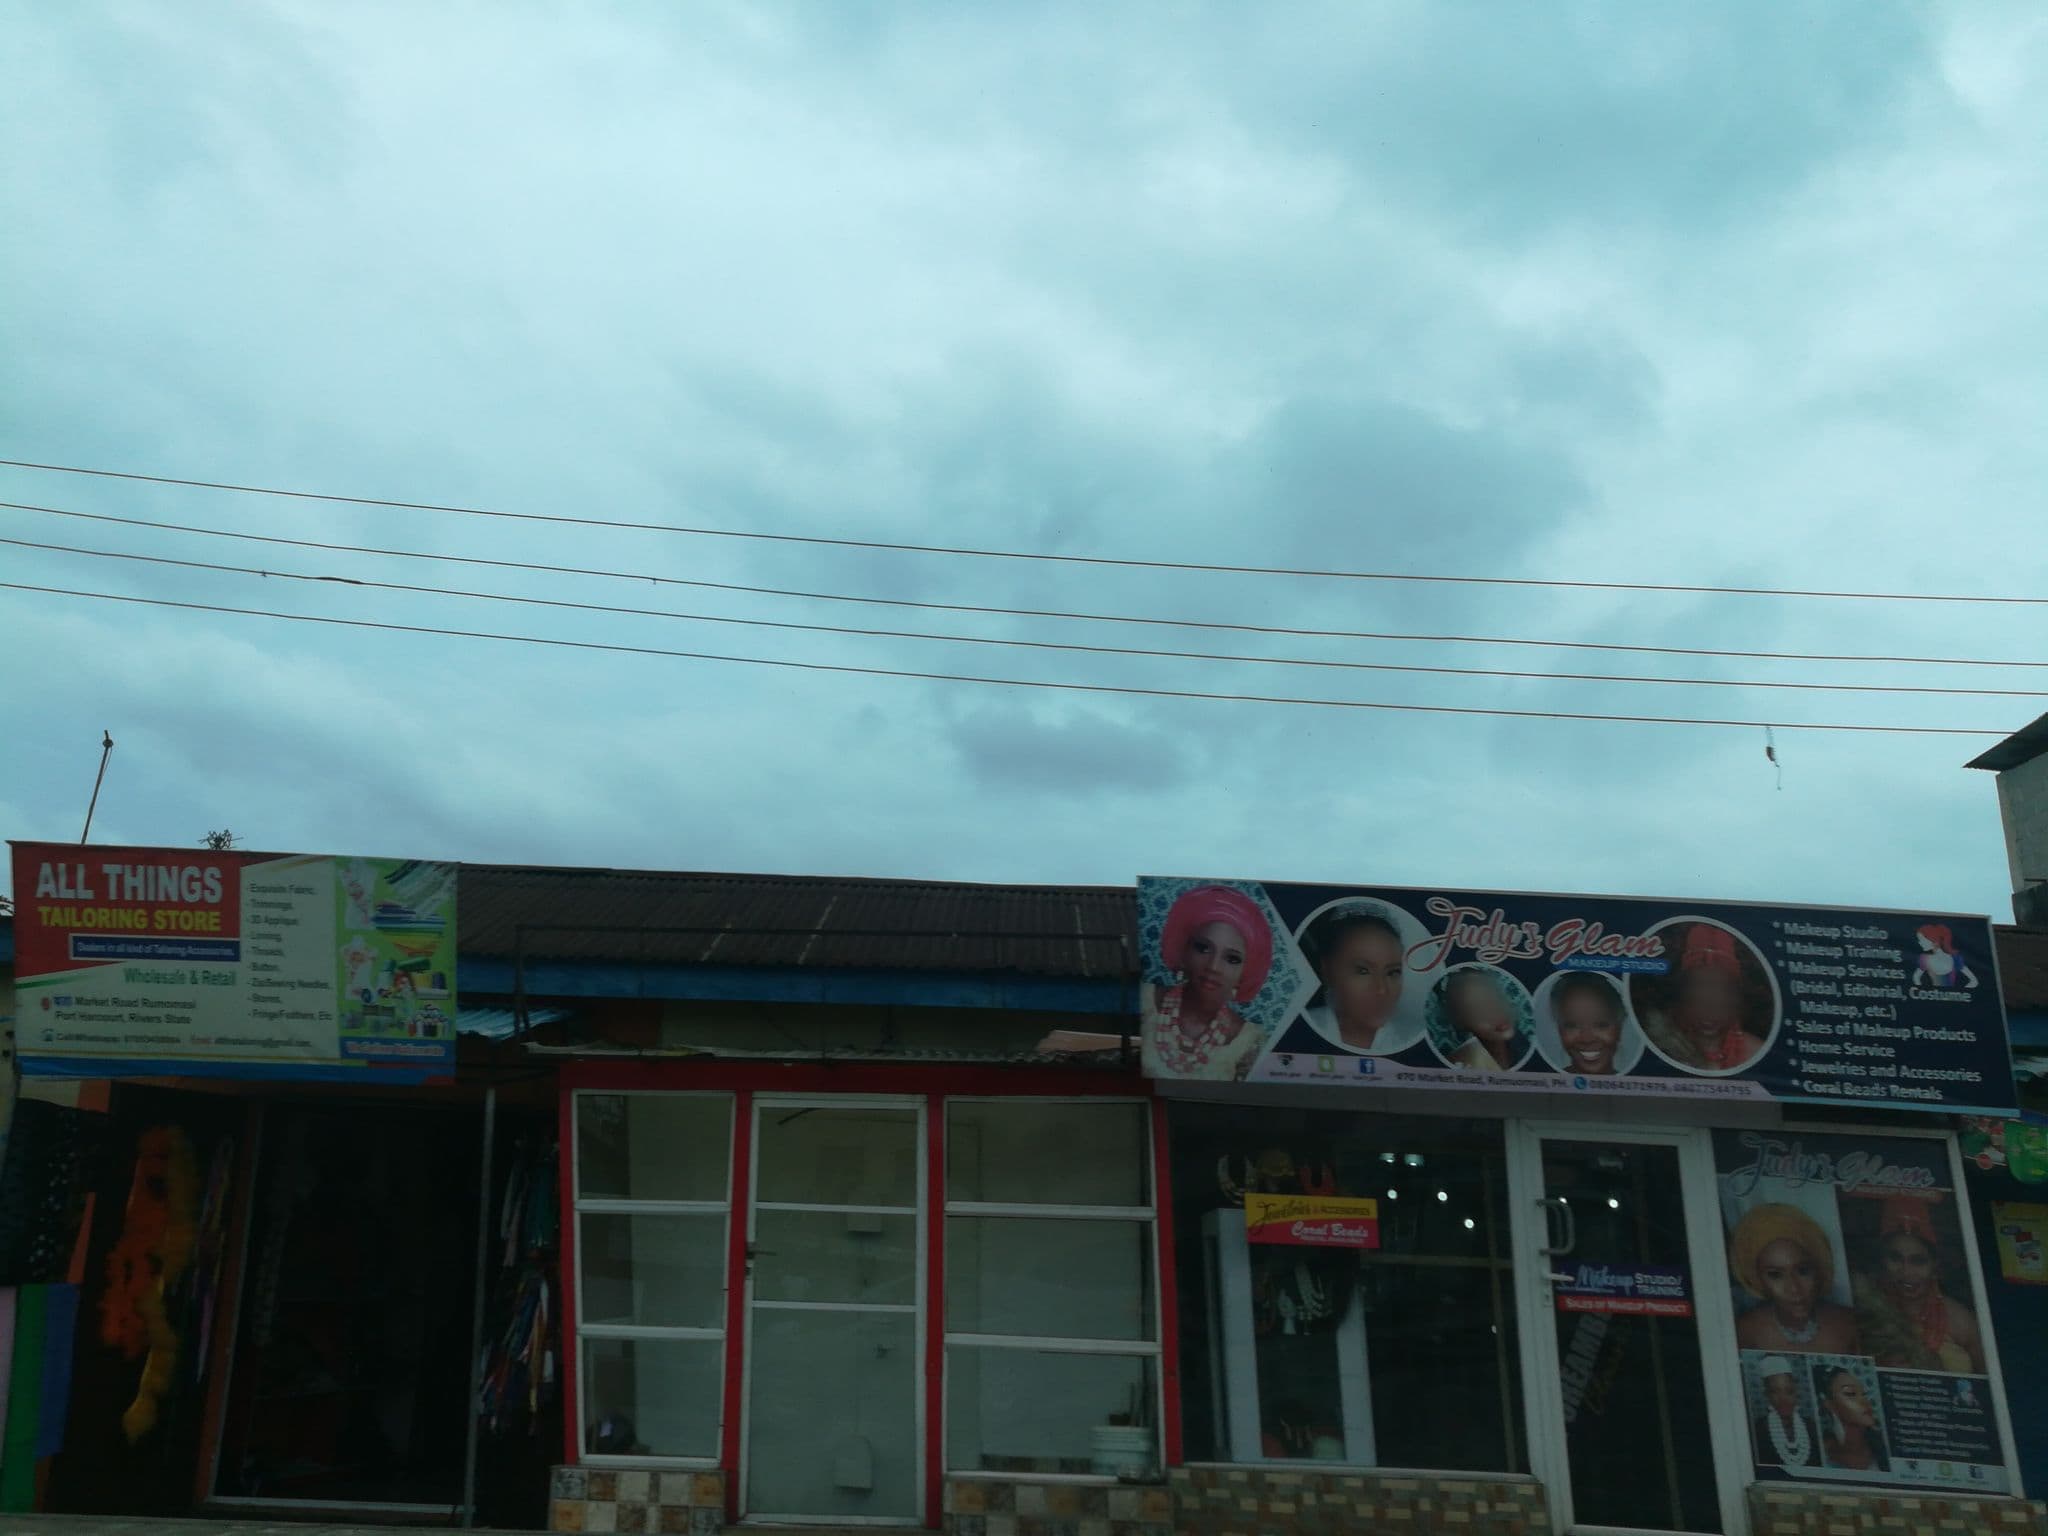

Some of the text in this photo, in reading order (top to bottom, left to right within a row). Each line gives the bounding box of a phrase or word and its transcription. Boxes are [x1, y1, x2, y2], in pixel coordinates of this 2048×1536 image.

[35, 861, 223, 903] ALL THINGS
[37, 906, 221, 932] TAILORING STORE
[1404, 896, 1666, 972] Judy's Glam
[1783, 922, 1889, 940] Makeup Studio
[154, 944, 186, 957] Tailoring
[1785, 942, 1903, 962] Makeup Training
[1568, 957, 1666, 971] MAKEUP STUDIO
[1788, 961, 1905, 980] Makeup Services
[124, 967, 236, 986] Wholesale & Retail
[1790, 979, 1972, 1003] (Bridal, Editorial, Costume
[75, 997, 109, 1007] Market
[112, 998, 138, 1008] Road
[1799, 1000, 1897, 1021] Makeup, etc.)
[55, 1010, 76, 1020] Port
[129, 1013, 162, 1023] Rivers
[165, 1014, 192, 1024] State
[1795, 1020, 1977, 1042] Sales of Makeup Products
[1797, 1040, 1896, 1058] Home Service
[1418, 1073, 1455, 1083] Market
[1800, 1060, 1983, 1082] Jewelries and Accessories
[1802, 1080, 1944, 1100] Coral Beads Rentals
[1725, 1131, 1936, 1198] Judy's Glam
[1291, 1220, 1369, 1238] Coral Beads
[1636, 1285, 1686, 1297] TRAINING
